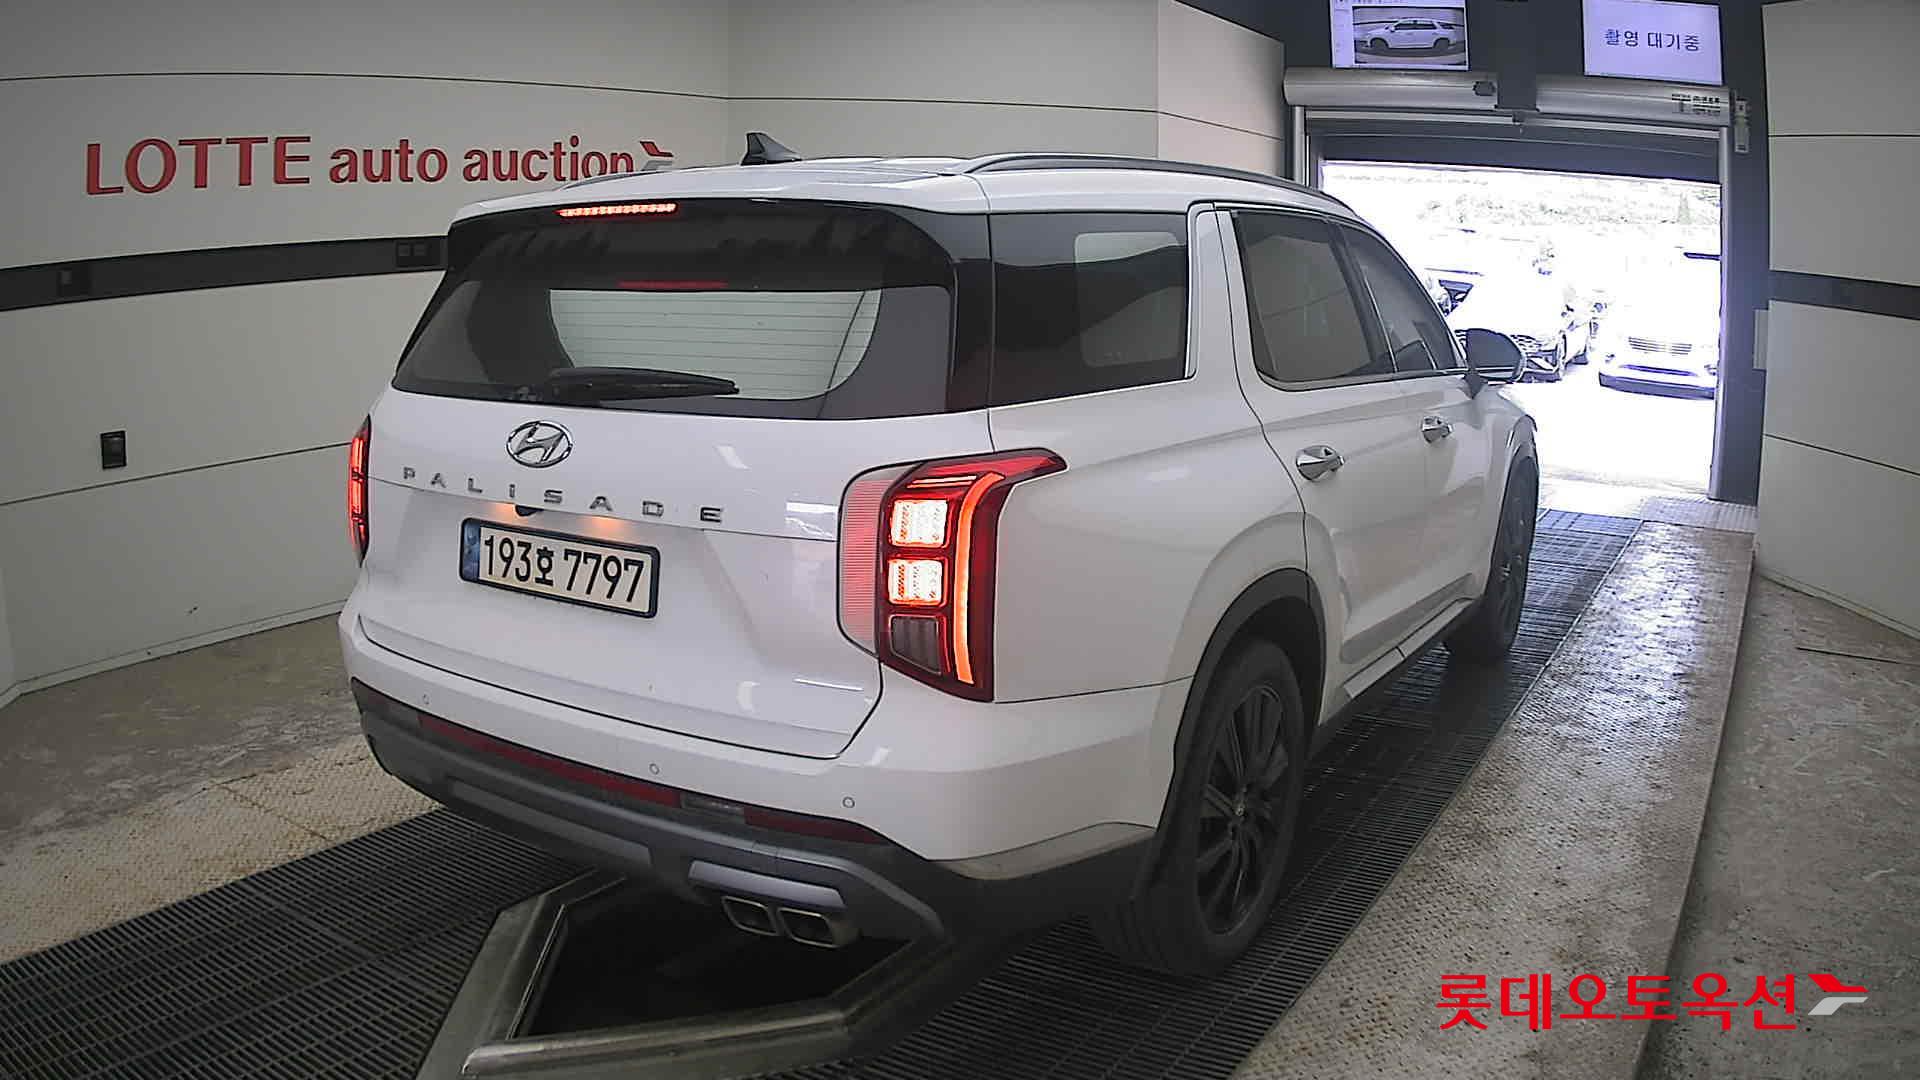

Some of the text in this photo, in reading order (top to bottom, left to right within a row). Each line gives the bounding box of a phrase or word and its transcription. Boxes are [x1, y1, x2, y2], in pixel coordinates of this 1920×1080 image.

[1647, 32, 1700, 52] 대기중
[86, 135, 634, 195] LOTTE auto auction
[403, 466, 724, 523] PALISADE
[484, 535, 645, 603] 193호 7797
